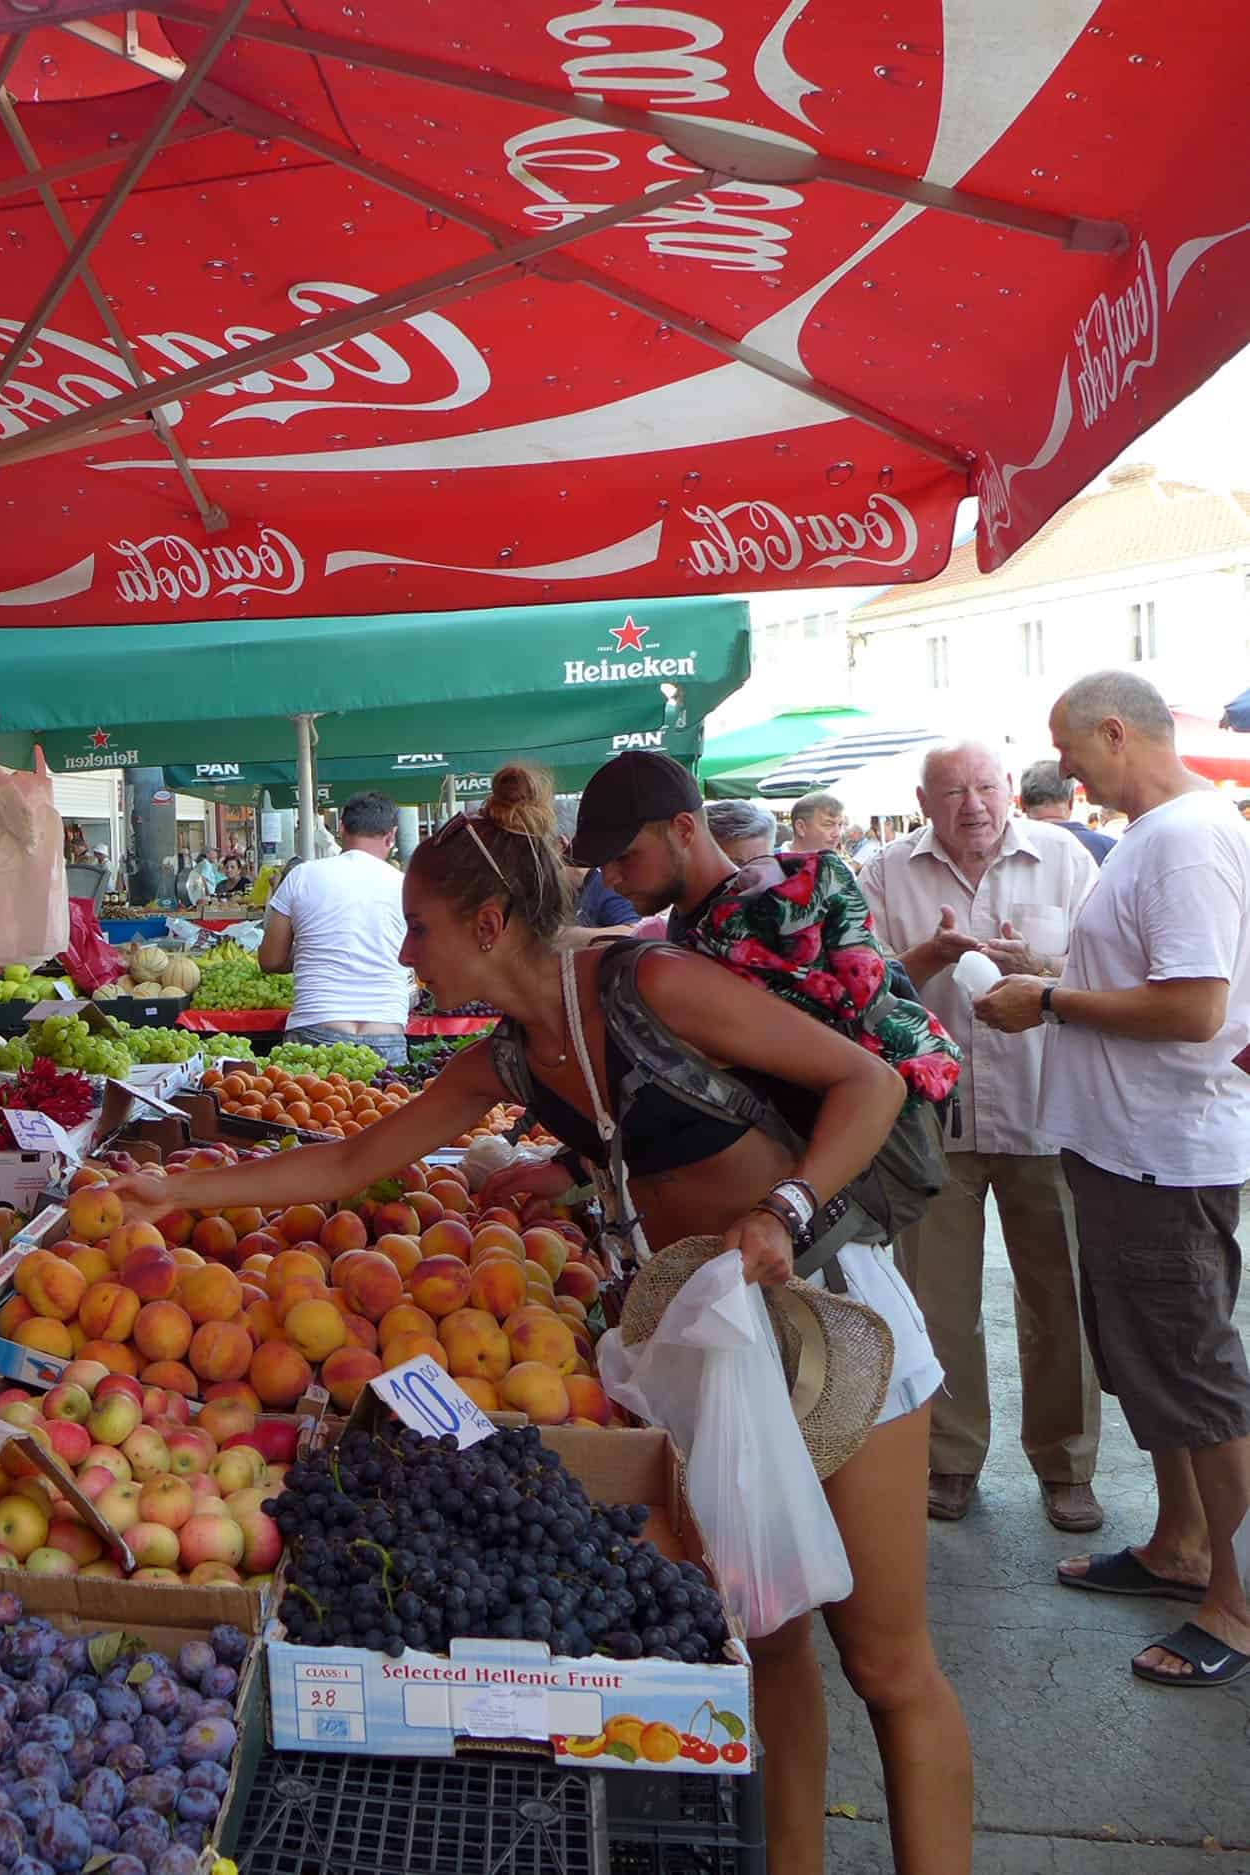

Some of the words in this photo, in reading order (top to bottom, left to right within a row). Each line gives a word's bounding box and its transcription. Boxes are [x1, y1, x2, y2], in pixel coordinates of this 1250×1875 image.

[563, 655, 695, 684] Heineken
[613, 730, 662, 749] PAN
[195, 763, 239, 777] PAN
[390, 1371, 461, 1437] 10
[304, 1667, 342, 1679] CLASS:
[381, 1662, 467, 1682] Selected
[475, 1667, 559, 1686] Hellenic
[568, 1671, 623, 1689] Fruit
[310, 1688, 337, 1707] 28
